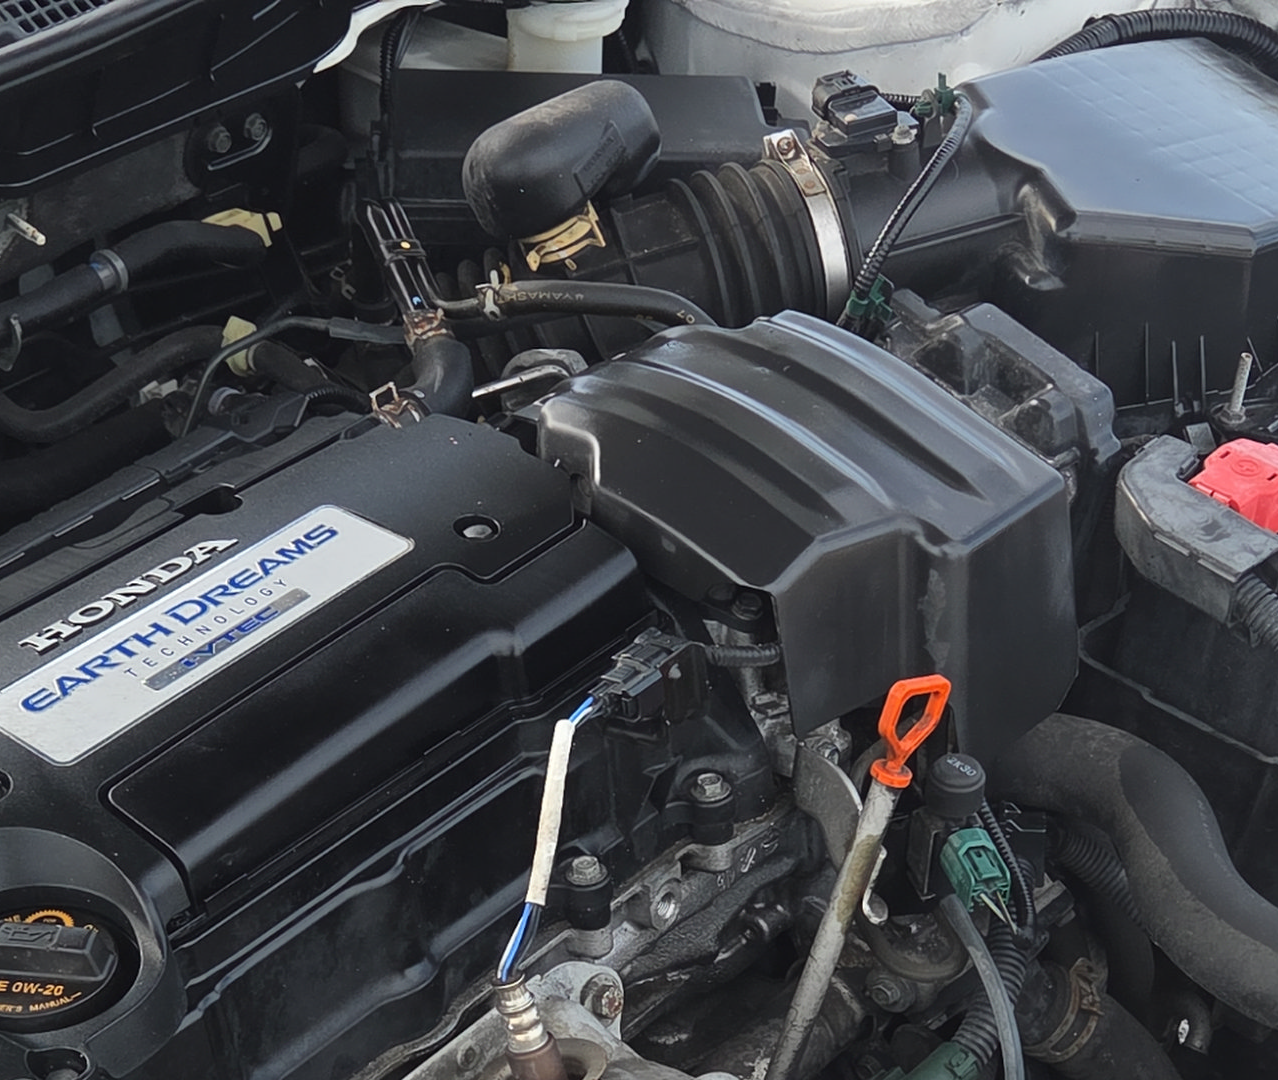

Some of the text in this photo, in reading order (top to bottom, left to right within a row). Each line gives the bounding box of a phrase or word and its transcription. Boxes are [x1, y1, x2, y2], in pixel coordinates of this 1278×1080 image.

[18, 537, 239, 656] HONDA
[20, 523, 340, 714] EARTH DREAMS
[123, 577, 290, 679] TECHNOLOGY
[178, 607, 281, 669] i-VTEC
[11, 981, 65, 997] 0W-20
[28, 996, 74, 1013] MANUAL
